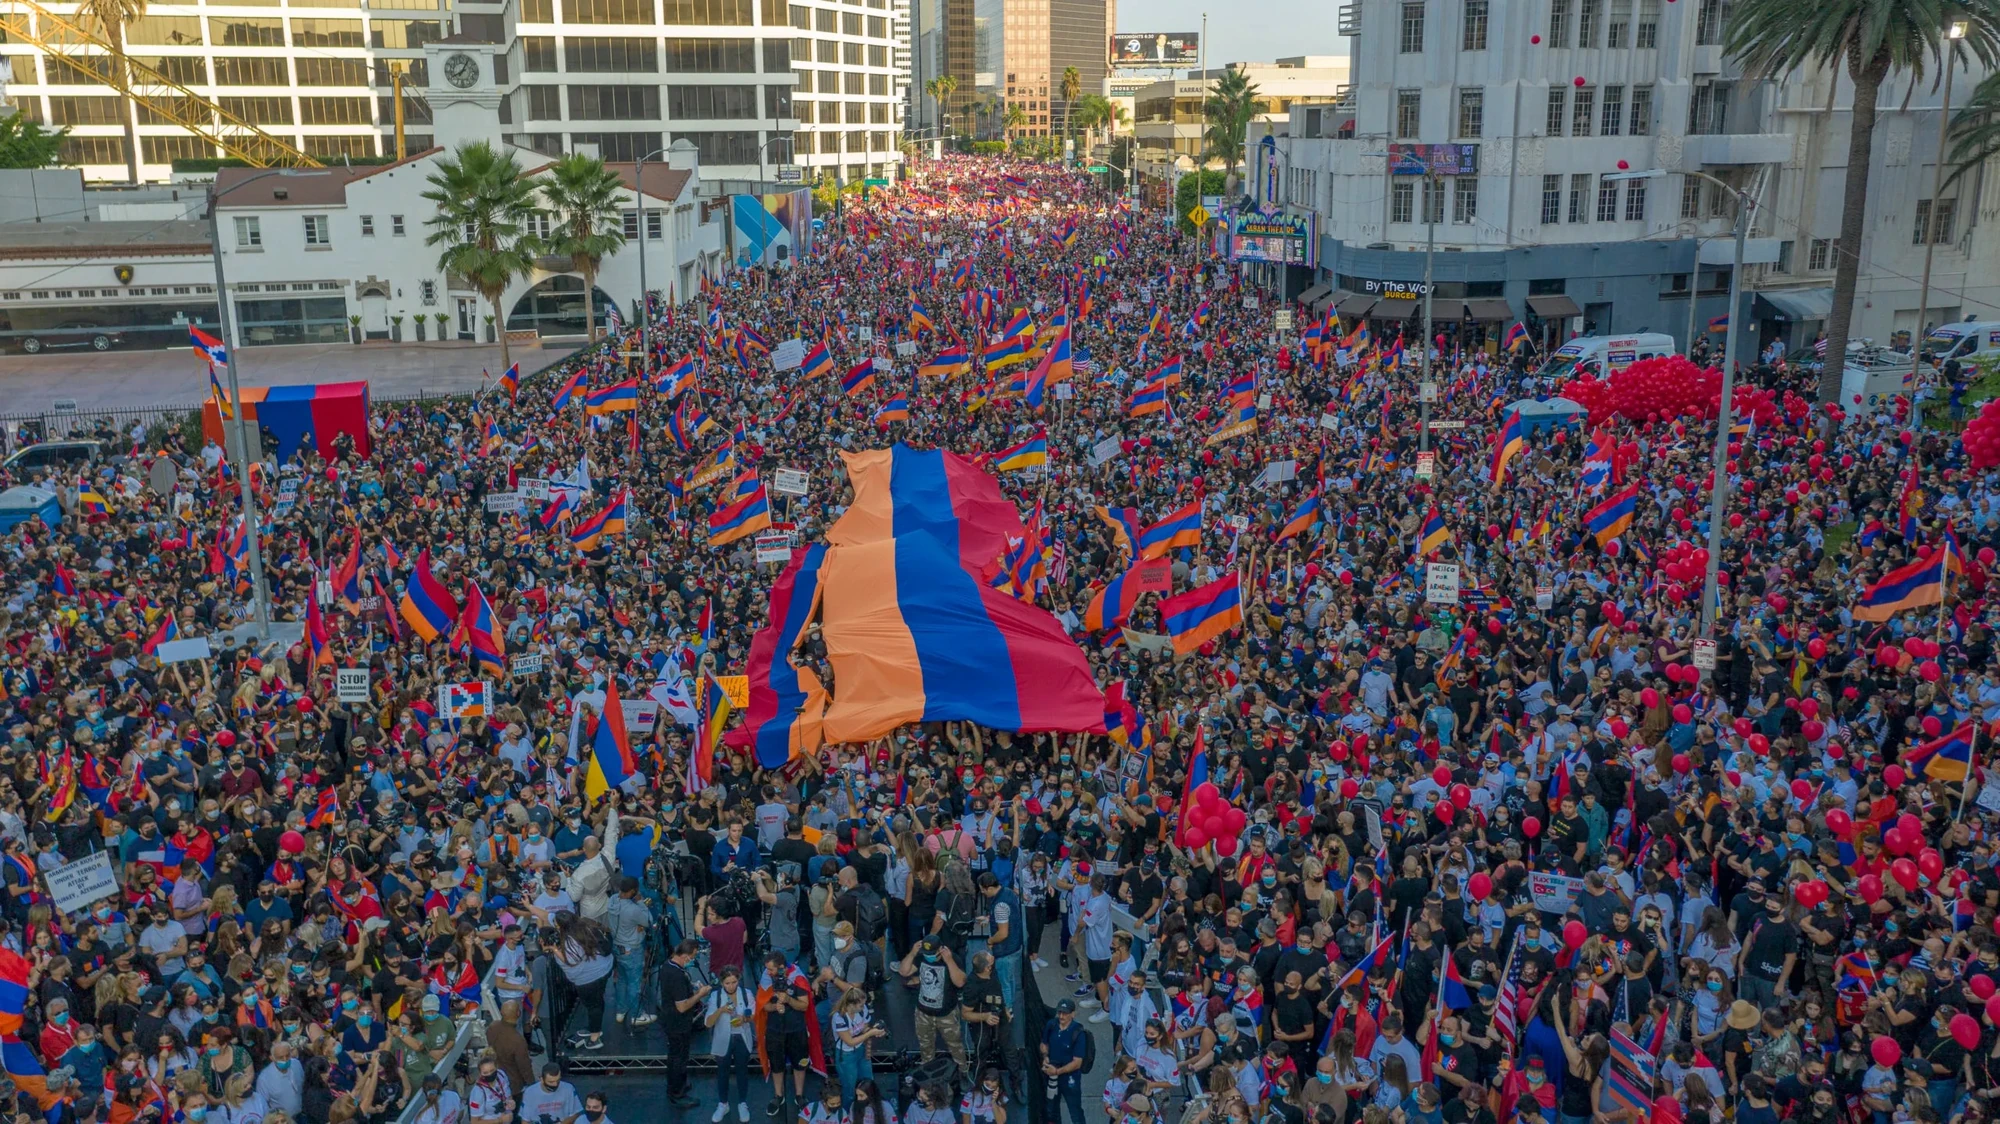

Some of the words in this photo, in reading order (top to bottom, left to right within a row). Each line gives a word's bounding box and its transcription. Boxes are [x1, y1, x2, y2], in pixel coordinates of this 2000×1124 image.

[1462, 146, 1474, 155] OCT
[1246, 225, 1266, 233] SABAN
[1267, 225, 1295, 234] THEARE
[1366, 281, 1380, 293] By
[1382, 281, 1405, 291] The
[1385, 291, 1416, 299] BURGER
[526, 489, 540, 497] NATO
[515, 657, 540, 667] TURKEY
[340, 675, 366, 684] STOP
[48, 863, 79, 878] ARMENIAN
[79, 857, 94, 865] KIDS
[54, 874, 74, 885] UNDER
[77, 863, 102, 875] TERROR
[68, 876, 89, 888] ATTACK
[80, 878, 113, 895] AZERBAIJAN
